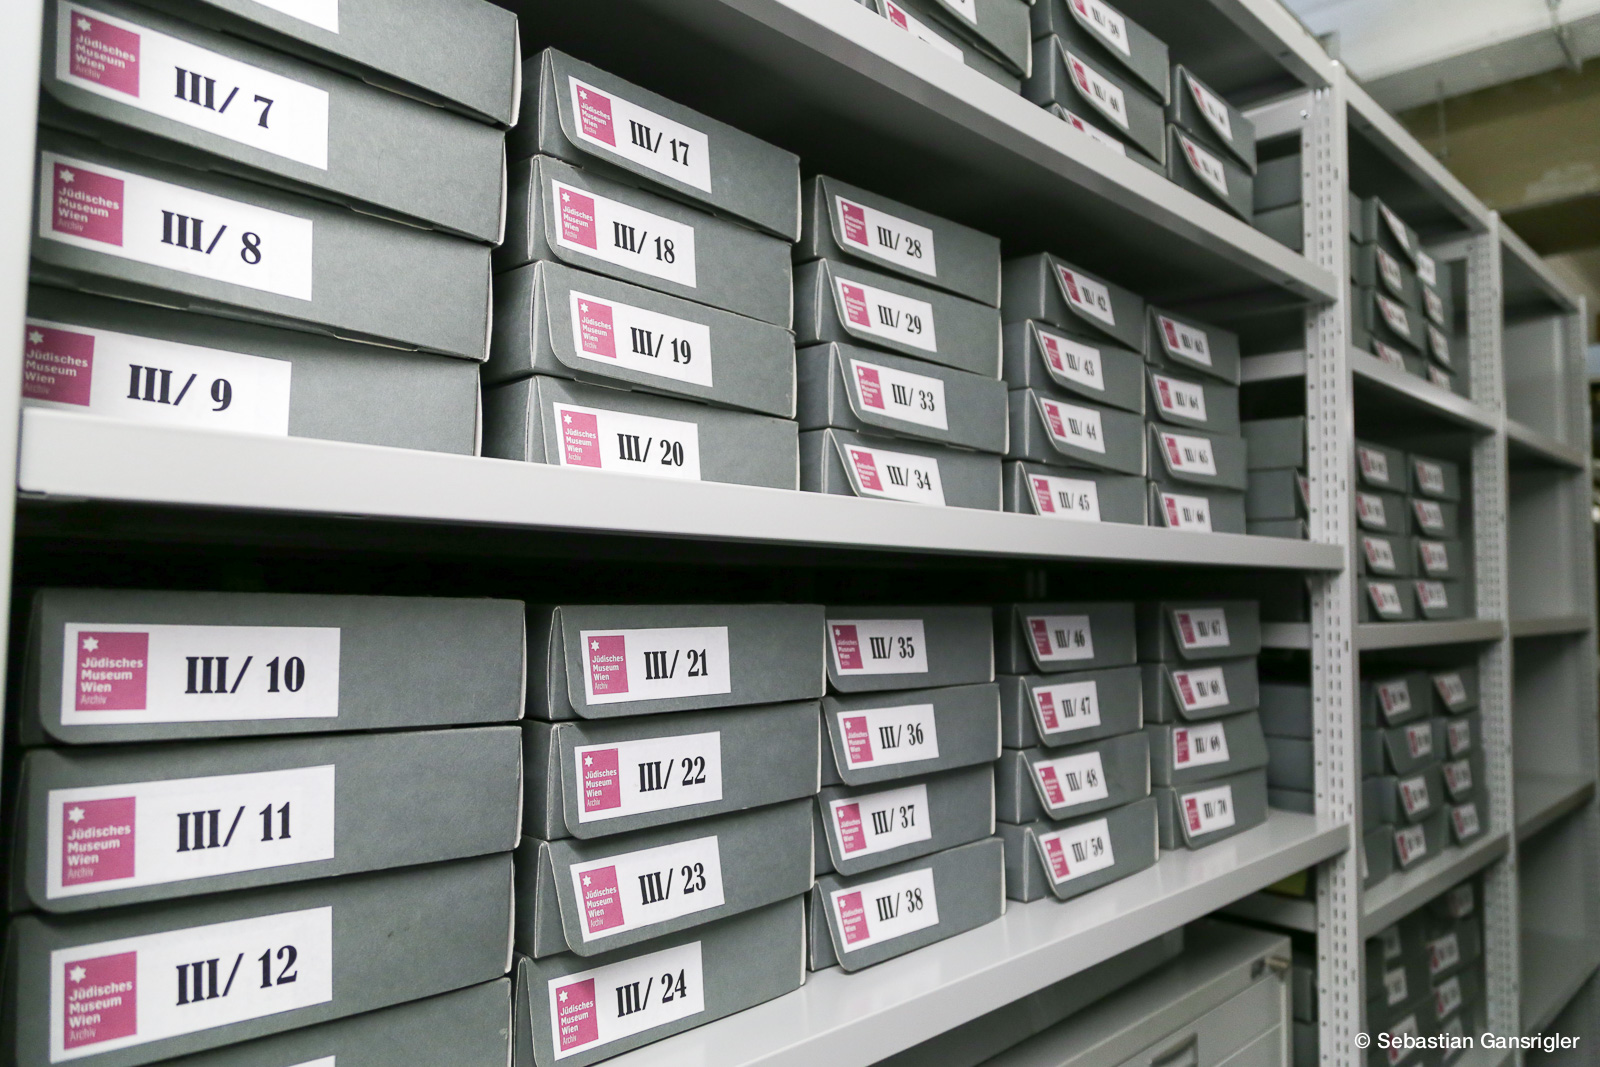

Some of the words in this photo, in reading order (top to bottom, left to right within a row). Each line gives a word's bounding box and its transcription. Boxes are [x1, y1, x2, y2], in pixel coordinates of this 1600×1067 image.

[76, 35, 135, 62] Jüdisches
[76, 44, 125, 68] Museum
[76, 54, 104, 70] Wien
[175, 66, 239, 113] III/
[254, 95, 273, 128] 7
[581, 103, 610, 120] Jüdisches
[582, 109, 606, 125] Museum
[583, 117, 598, 128] Wien
[584, 124, 596, 134] Archiv
[629, 120, 662, 153] III/
[670, 139, 689, 166] 17
[59, 188, 119, 210] Jüdisches
[60, 197, 108, 217] Museum
[59, 208, 88, 222] Wien
[563, 206, 593, 221] Jüdisches
[564, 213, 588, 227] Museum
[564, 221, 579, 232] Wien
[565, 229, 577, 238] Archiv
[161, 210, 227, 254] III/
[241, 232, 261, 264] 8
[613, 222, 647, 254] III/
[654, 236, 674, 264] 18
[877, 226, 900, 250] III/
[906, 237, 922, 258] 28
[1082, 286, 1097, 306] III/
[1098, 296, 1107, 311] 42
[582, 317, 611, 329] Jüdisches
[878, 305, 900, 328] III/
[906, 314, 921, 334] 29
[583, 324, 607, 336] Museum
[583, 332, 598, 342] Wien
[584, 341, 596, 349] Archiv
[630, 327, 664, 358] III/
[671, 338, 691, 364] 19
[26, 350, 88, 367] Jüdisches
[1066, 353, 1081, 372] III/
[1084, 360, 1094, 376] 43
[26, 360, 76, 376] Museum
[26, 372, 55, 384] Wien
[127, 364, 197, 406] III/
[211, 379, 232, 411] 9
[892, 384, 913, 406] III/
[919, 390, 934, 411] 33
[566, 428, 596, 438] Jüdisches
[1068, 418, 1082, 436] III/
[1087, 424, 1096, 439] 44
[566, 436, 592, 446] Museum
[617, 434, 652, 462] III/
[660, 440, 683, 466] 20
[887, 466, 908, 486] III/
[914, 470, 931, 490] 34
[1058, 492, 1074, 508] III/
[1079, 494, 1090, 510] 45
[1054, 629, 1070, 648] III/
[1073, 630, 1085, 647] 46
[870, 637, 892, 659] III/
[898, 637, 914, 658] 35
[82, 658, 143, 668] Jüdisches
[592, 655, 623, 663] Jüdisches
[644, 650, 679, 680] III/
[687, 649, 708, 677] 21
[82, 670, 132, 680] Museum
[185, 656, 253, 694] III/
[266, 656, 304, 692] 10
[82, 682, 111, 692] Wien
[81, 694, 106, 704] Archiv
[1062, 699, 1076, 718] III/
[1081, 697, 1090, 715] 47
[879, 725, 901, 749] III/
[907, 723, 923, 745] 36
[585, 769, 616, 779] Jüdisches
[638, 759, 674, 792] III/
[682, 756, 706, 786] 22
[1066, 772, 1082, 791] III/
[1087, 769, 1097, 787] 48
[586, 780, 612, 788] Museum
[177, 806, 245, 852] III/
[260, 802, 291, 841] 11
[872, 808, 894, 835] III/
[900, 804, 915, 828] 37
[68, 826, 130, 840] Jüdisches
[68, 839, 120, 852] Museum
[1072, 840, 1088, 862] III/
[1092, 837, 1103, 856] 59
[68, 855, 98, 865] Wien
[68, 868, 94, 878] Archiv
[638, 868, 673, 905] III/
[682, 863, 706, 894] 23
[586, 887, 616, 899] Jüdisches
[587, 898, 613, 908] Museum
[876, 893, 900, 921] III/
[906, 888, 923, 912] 38
[588, 909, 604, 918] Wien
[591, 918, 603, 927] Archiv
[176, 953, 244, 1006] III/
[258, 945, 297, 988] 12
[70, 982, 132, 1000] Jüdisches
[616, 977, 653, 1018] III/
[661, 969, 686, 1003] 24
[70, 996, 121, 1014] Museum
[560, 1001, 593, 1016] Jüdisches
[70, 1014, 100, 1027] Wien
[561, 1012, 588, 1026] Museum
[70, 1028, 96, 1041] Archiv
[562, 1025, 578, 1035] Wien
[563, 1034, 576, 1045] Archiv
